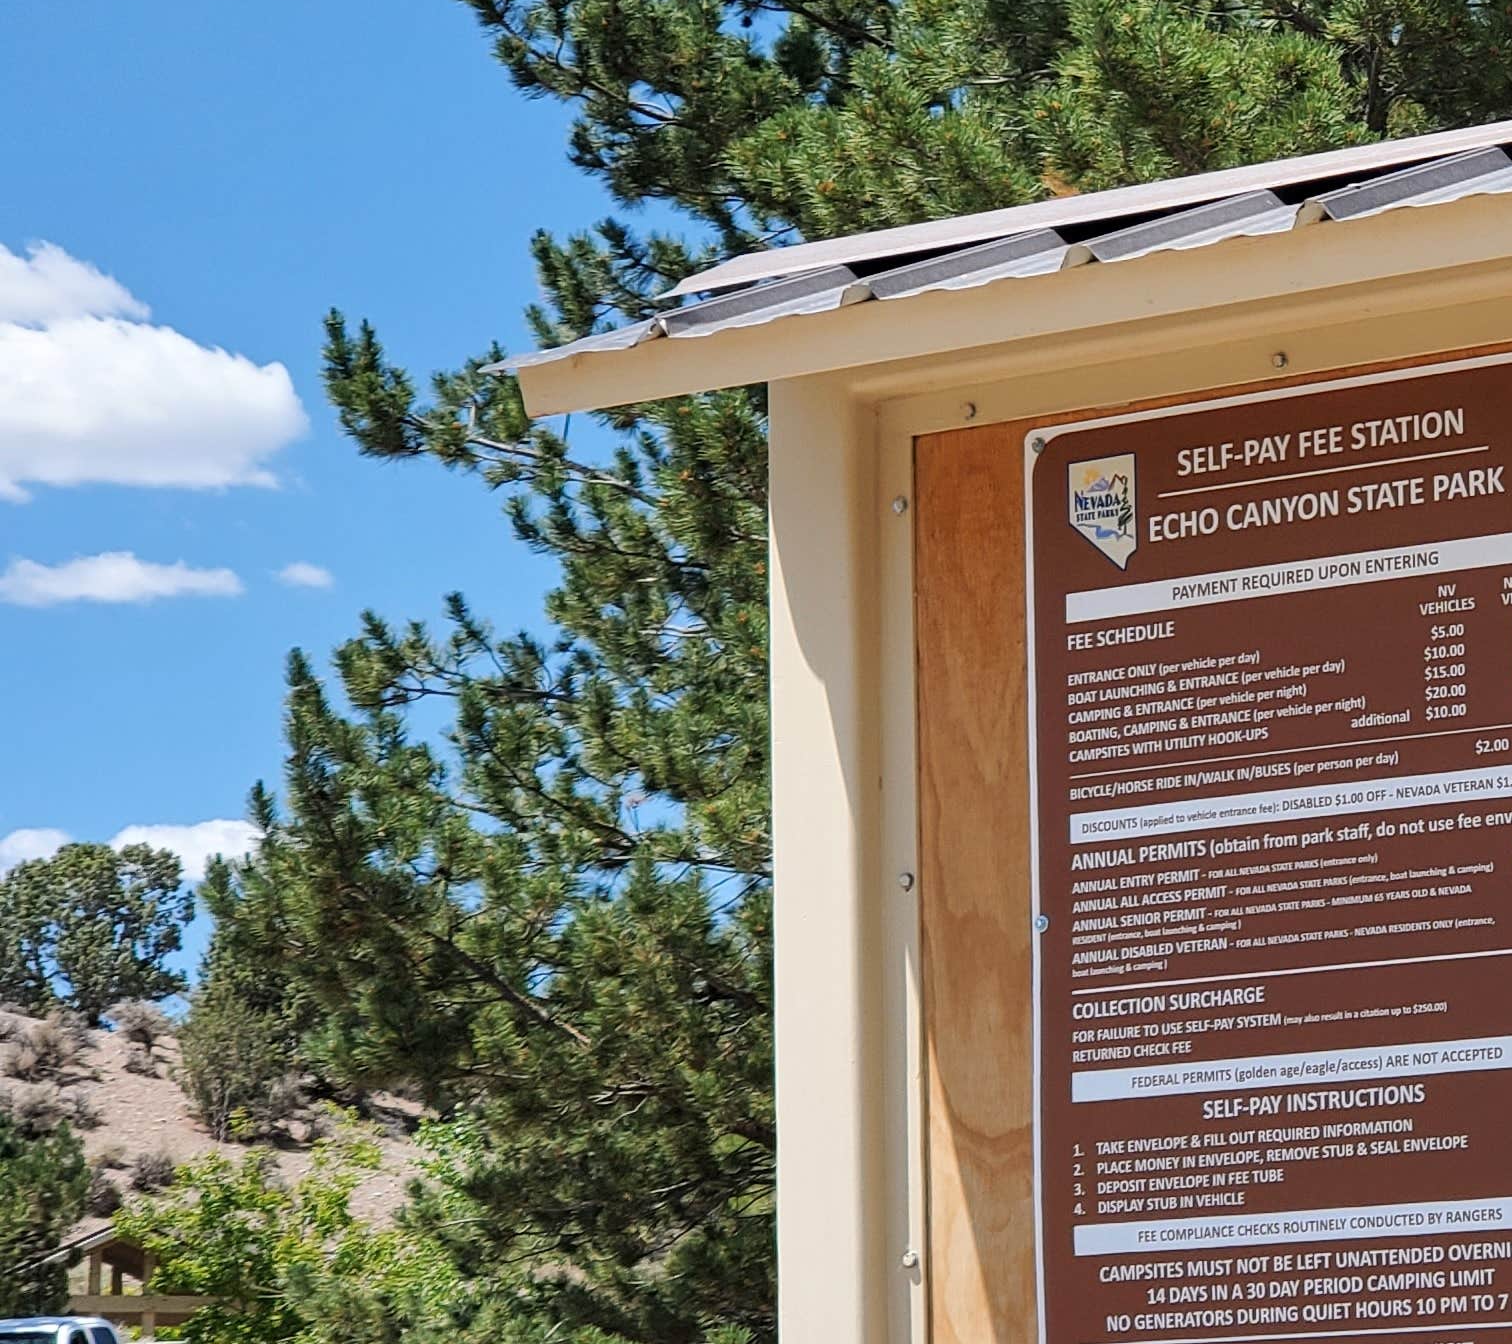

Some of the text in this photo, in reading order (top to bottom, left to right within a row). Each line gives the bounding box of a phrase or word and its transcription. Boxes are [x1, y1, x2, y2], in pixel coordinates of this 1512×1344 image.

[1177, 407, 1464, 476] SELF-PAY FEE STATION
[1075, 490, 1121, 512] NEVADA
[1149, 465, 1505, 542] ECHO CANYON STATE PARK
[1172, 550, 1439, 601] PAYMENT REQUIRED UPON ENTERING
[1437, 583, 1456, 598] NV
[1418, 596, 1475, 616] VEHICLES
[1067, 620, 1175, 651] FEE SCHEDULE
[1430, 623, 1464, 641] $5.00
[1067, 649, 1260, 686] ENTRANCE ONLY (per vehicle per day)
[1424, 683, 1466, 701] $20.00
[1068, 695, 1366, 743] BOATING, CAMPING & ENTRANCE (per vehicle per night)
[1350, 708, 1410, 728] additional
[1425, 703, 1467, 721] $10.00
[1068, 726, 1269, 763] CAMPSITES WITH UTILITY HOOK-UPS
[1081, 817, 1138, 834] DISCOUNTS
[1139, 813, 1174, 829] (applied
[1175, 814, 1185, 823] to
[1186, 809, 1217, 822] vehicle
[1218, 806, 1257, 818] entrance
[1258, 802, 1280, 814] fee):
[1281, 795, 1332, 811] DISABLED
[1334, 791, 1364, 807] $1.00
[1365, 788, 1387, 802] OFF
[1395, 783, 1441, 799] NEVADA
[1442, 777, 1494, 794] VETERAN
[1070, 847, 1136, 871] ANNUAL
[1138, 839, 1207, 863] PERMITS
[1209, 835, 1260, 858] (obtain
[1262, 832, 1298, 849] from
[1301, 826, 1334, 848] park
[1336, 822, 1373, 841] staff,
[1375, 820, 1395, 837] do
[1399, 818, 1425, 835] not
[1428, 818, 1454, 832] use
[1456, 812, 1482, 829] fee
[1072, 985, 1265, 1020] COLLECTION SURCHARGE
[1131, 1046, 1503, 1089] FEDERAL PERMITS (golden age/eagle/access) ARE NOT ACCEPTED
[1202, 1083, 1425, 1119] SELF-PAY INSTRUCTIONS
[1073, 1168, 1284, 1196] 3. DEPOSIT ENVELOPE IN FEE TUBE
[1137, 1207, 1503, 1243] FEE COMPLIANCE CHECKS ROUTINELY CONDUCTED BY RANGERS
[1099, 1261, 1184, 1282] CAMPSITES
[1186, 1258, 1233, 1277] MUST
[1236, 1255, 1270, 1274] NOT
[1272, 1254, 1293, 1272] BE
[1296, 1251, 1332, 1270] LEFT
[1335, 1246, 1444, 1268] UNATTENDED
[1146, 1267, 1496, 1304] 14 DAYS IN A 30 DAY PERIOD CAMPING LIMIT
[1106, 1314, 1131, 1332] NO
[1133, 1308, 1233, 1330] GENERATORS
[1236, 1305, 1299, 1325] DURING
[1302, 1301, 1352, 1322] QUIET
[1355, 1298, 1412, 1318] HOURS
[1415, 1296, 1436, 1315] 10
[1439, 1295, 1467, 1313] PM
[1470, 1294, 1494, 1311] TO
[1497, 1293, 1509, 1310] 7
